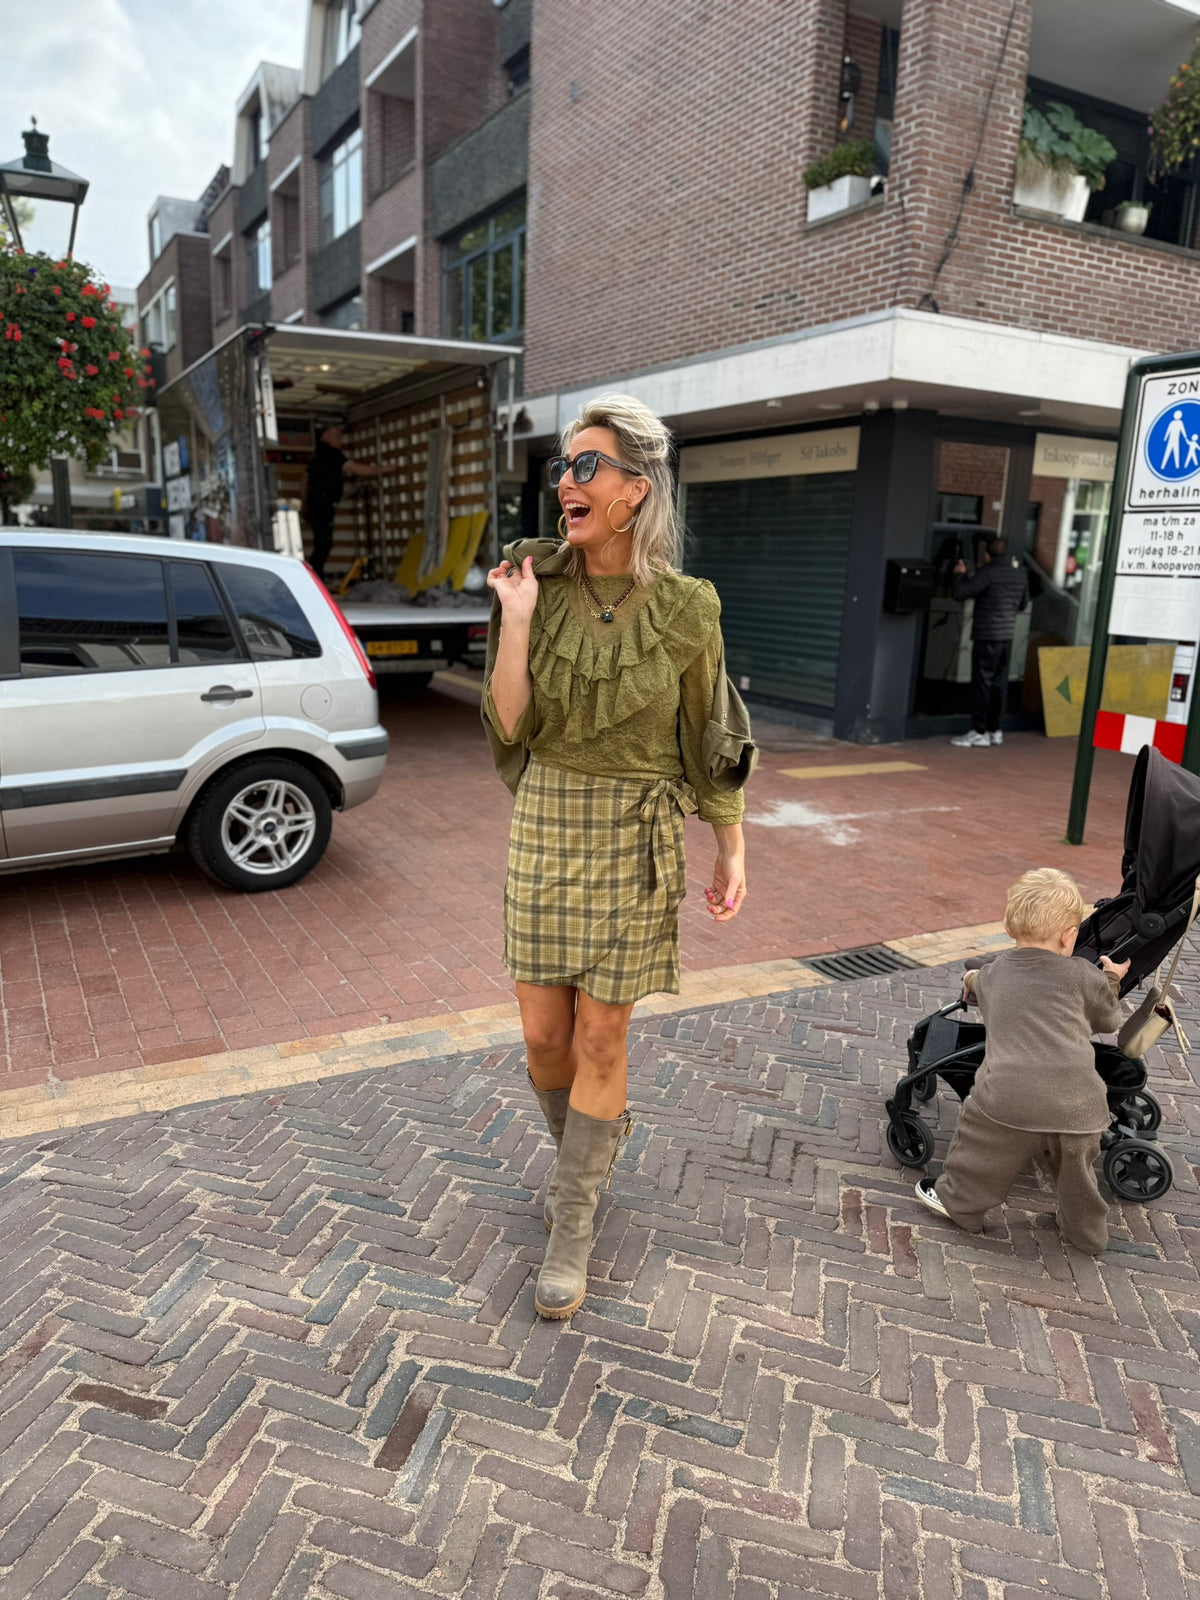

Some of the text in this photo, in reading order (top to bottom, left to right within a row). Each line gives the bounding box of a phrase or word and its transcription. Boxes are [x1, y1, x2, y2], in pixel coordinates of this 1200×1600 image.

[1167, 380, 1199, 396] ZON
[814, 442, 848, 461] Jakobs
[1043, 447, 1079, 469] Inkoop
[717, 455, 748, 469] Tommy
[750, 451, 782, 468] Hilfiger
[1139, 486, 1200, 499] herhalin
[1143, 515, 1196, 527] ma t/m za
[1150, 530, 1184, 541] 11-18 h
[1127, 545, 1164, 558] vrijdag
[1167, 545, 1194, 556] 18-21
[1121, 560, 1148, 570] i.v.m.
